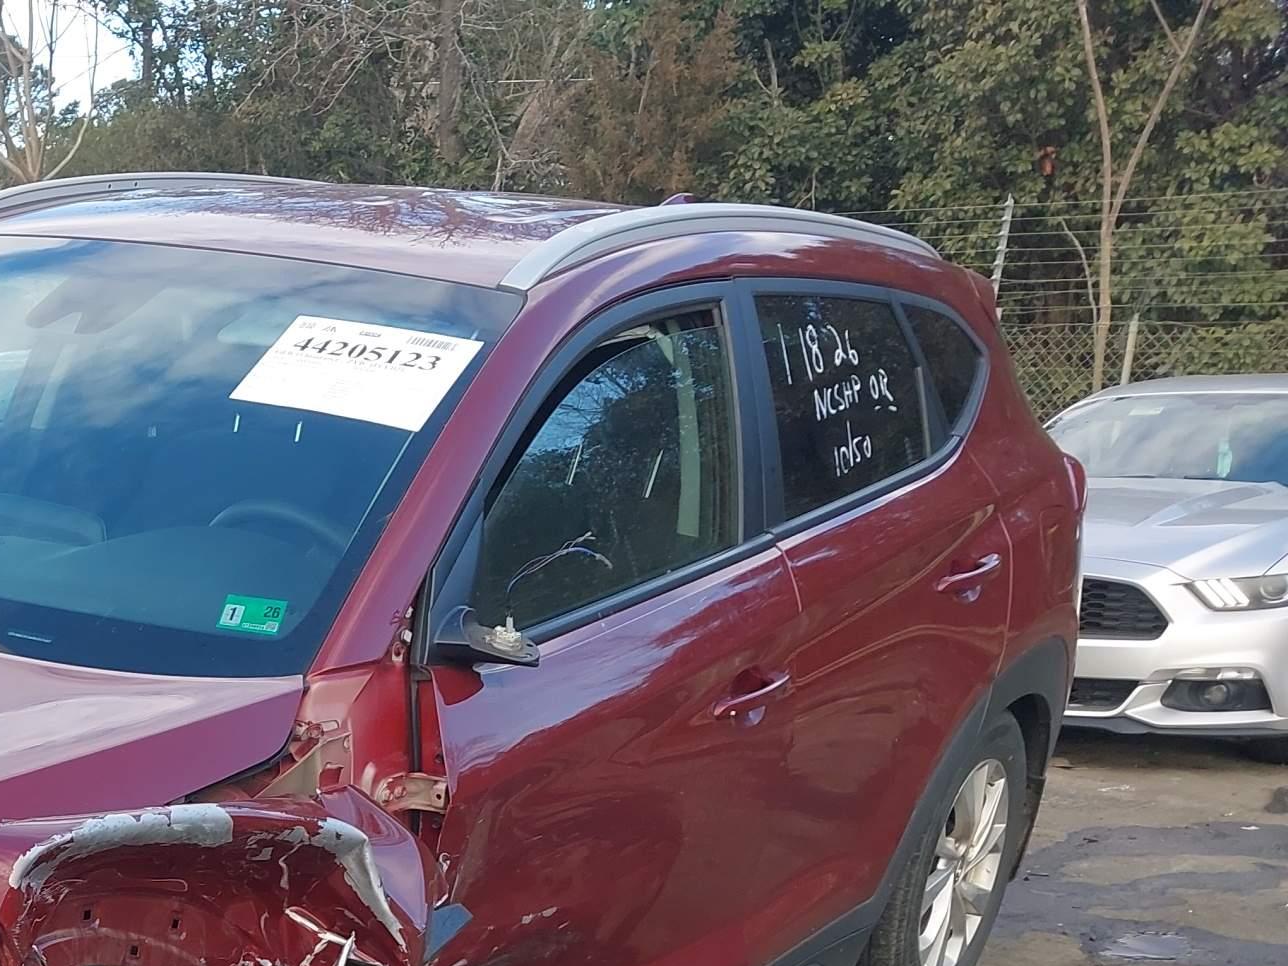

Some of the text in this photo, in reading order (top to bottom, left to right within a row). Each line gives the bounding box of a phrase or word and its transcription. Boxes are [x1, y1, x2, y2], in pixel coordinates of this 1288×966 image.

[293, 336, 441, 372] 44205123
[814, 374, 862, 421] NCSHP
[228, 606, 237, 621] 1
[263, 606, 281, 619] 26
